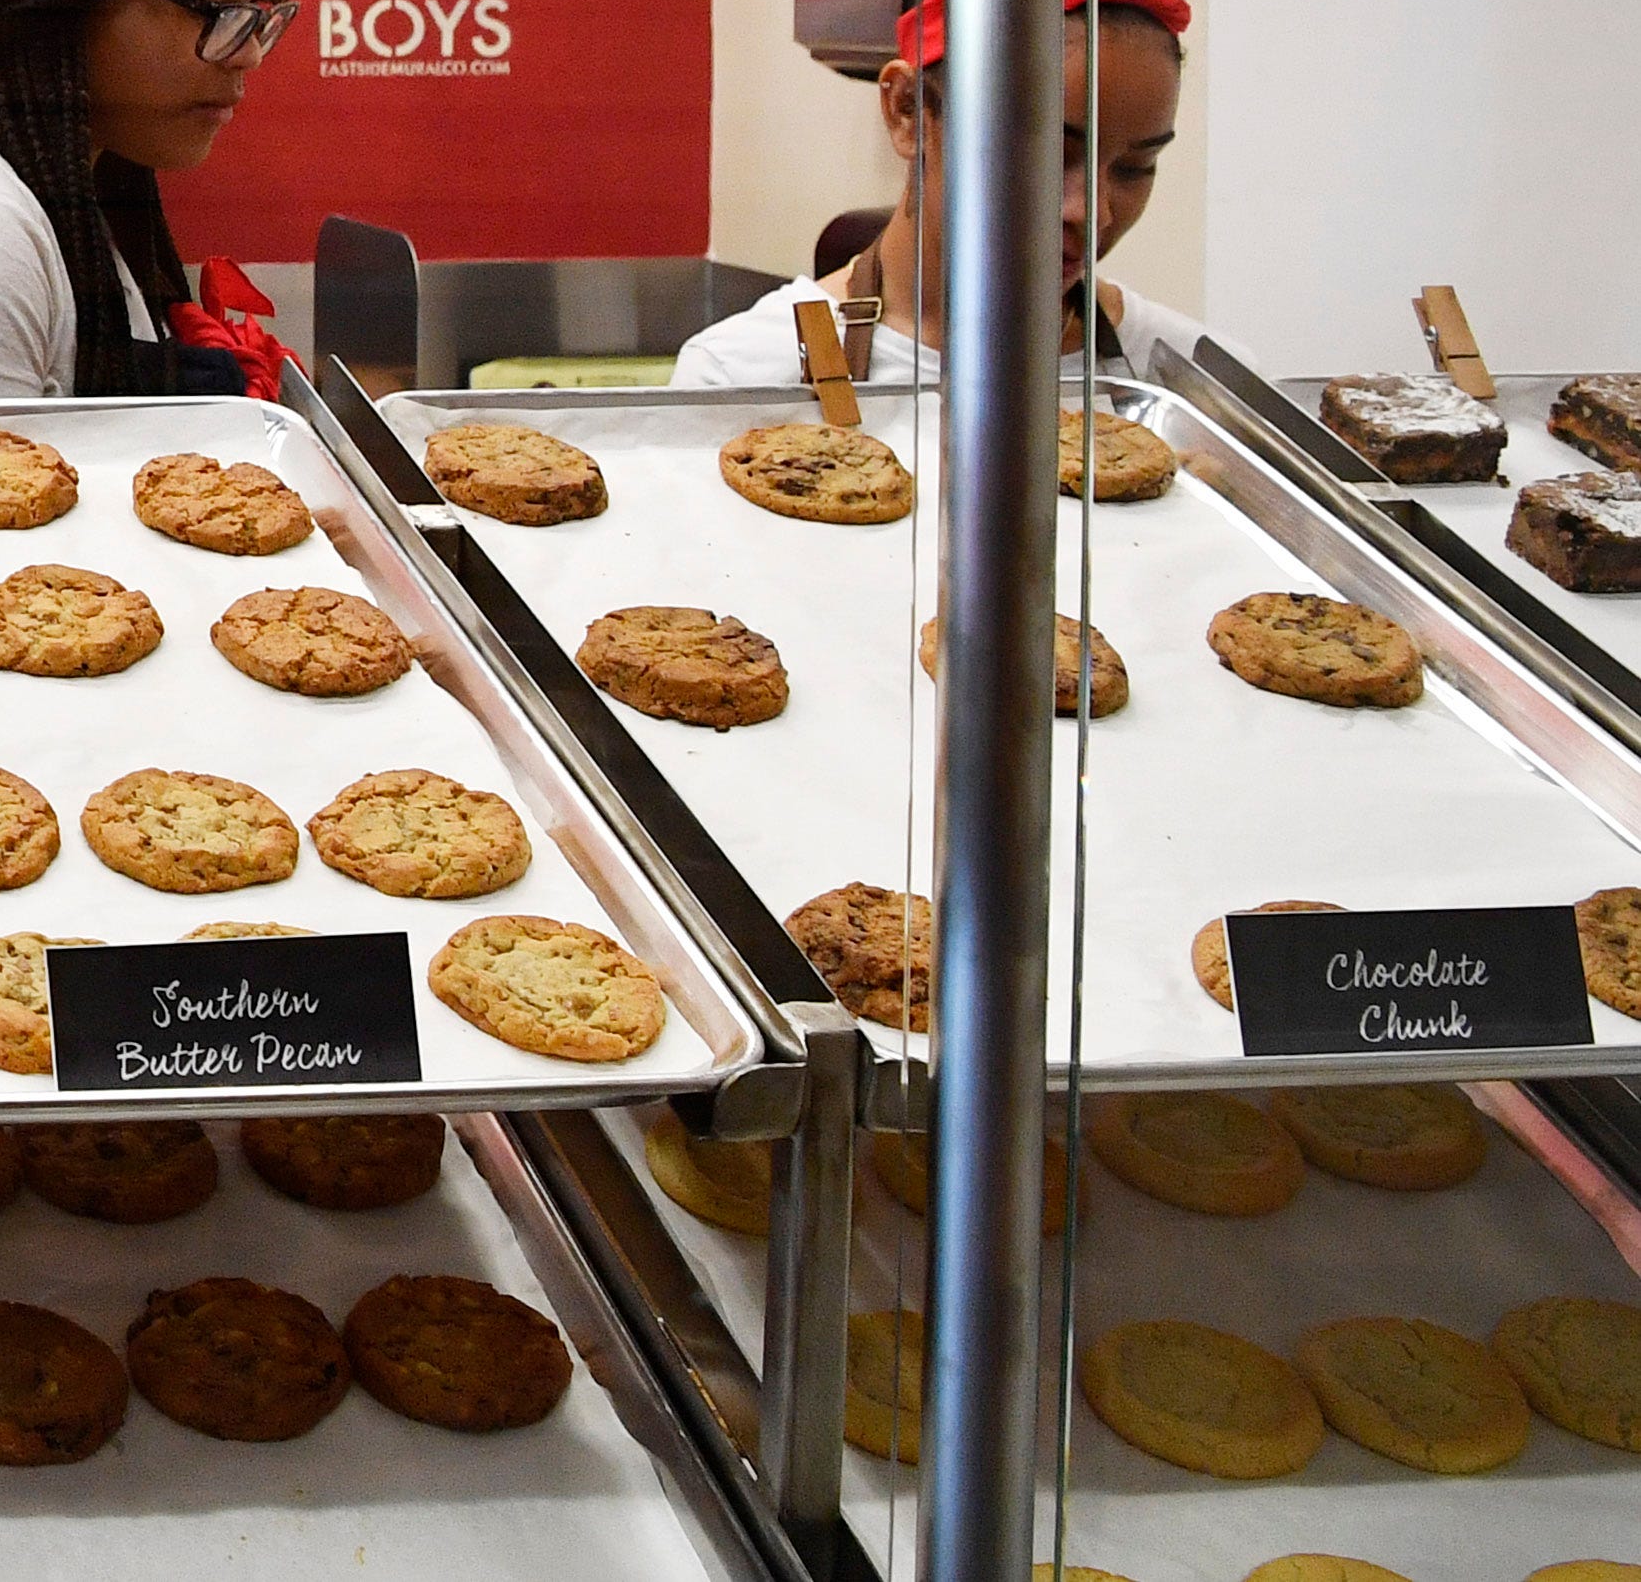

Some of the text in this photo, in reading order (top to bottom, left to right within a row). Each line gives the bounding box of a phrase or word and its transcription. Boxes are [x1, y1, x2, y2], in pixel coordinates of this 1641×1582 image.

[319, 60, 511, 78] EASTSIDEMURALCO.COM
[1325, 947, 1490, 992] Chocolate
[152, 978, 320, 1029] Southern
[1358, 999, 1473, 1043] Chunk
[115, 1031, 363, 1082] Butter Pecan
